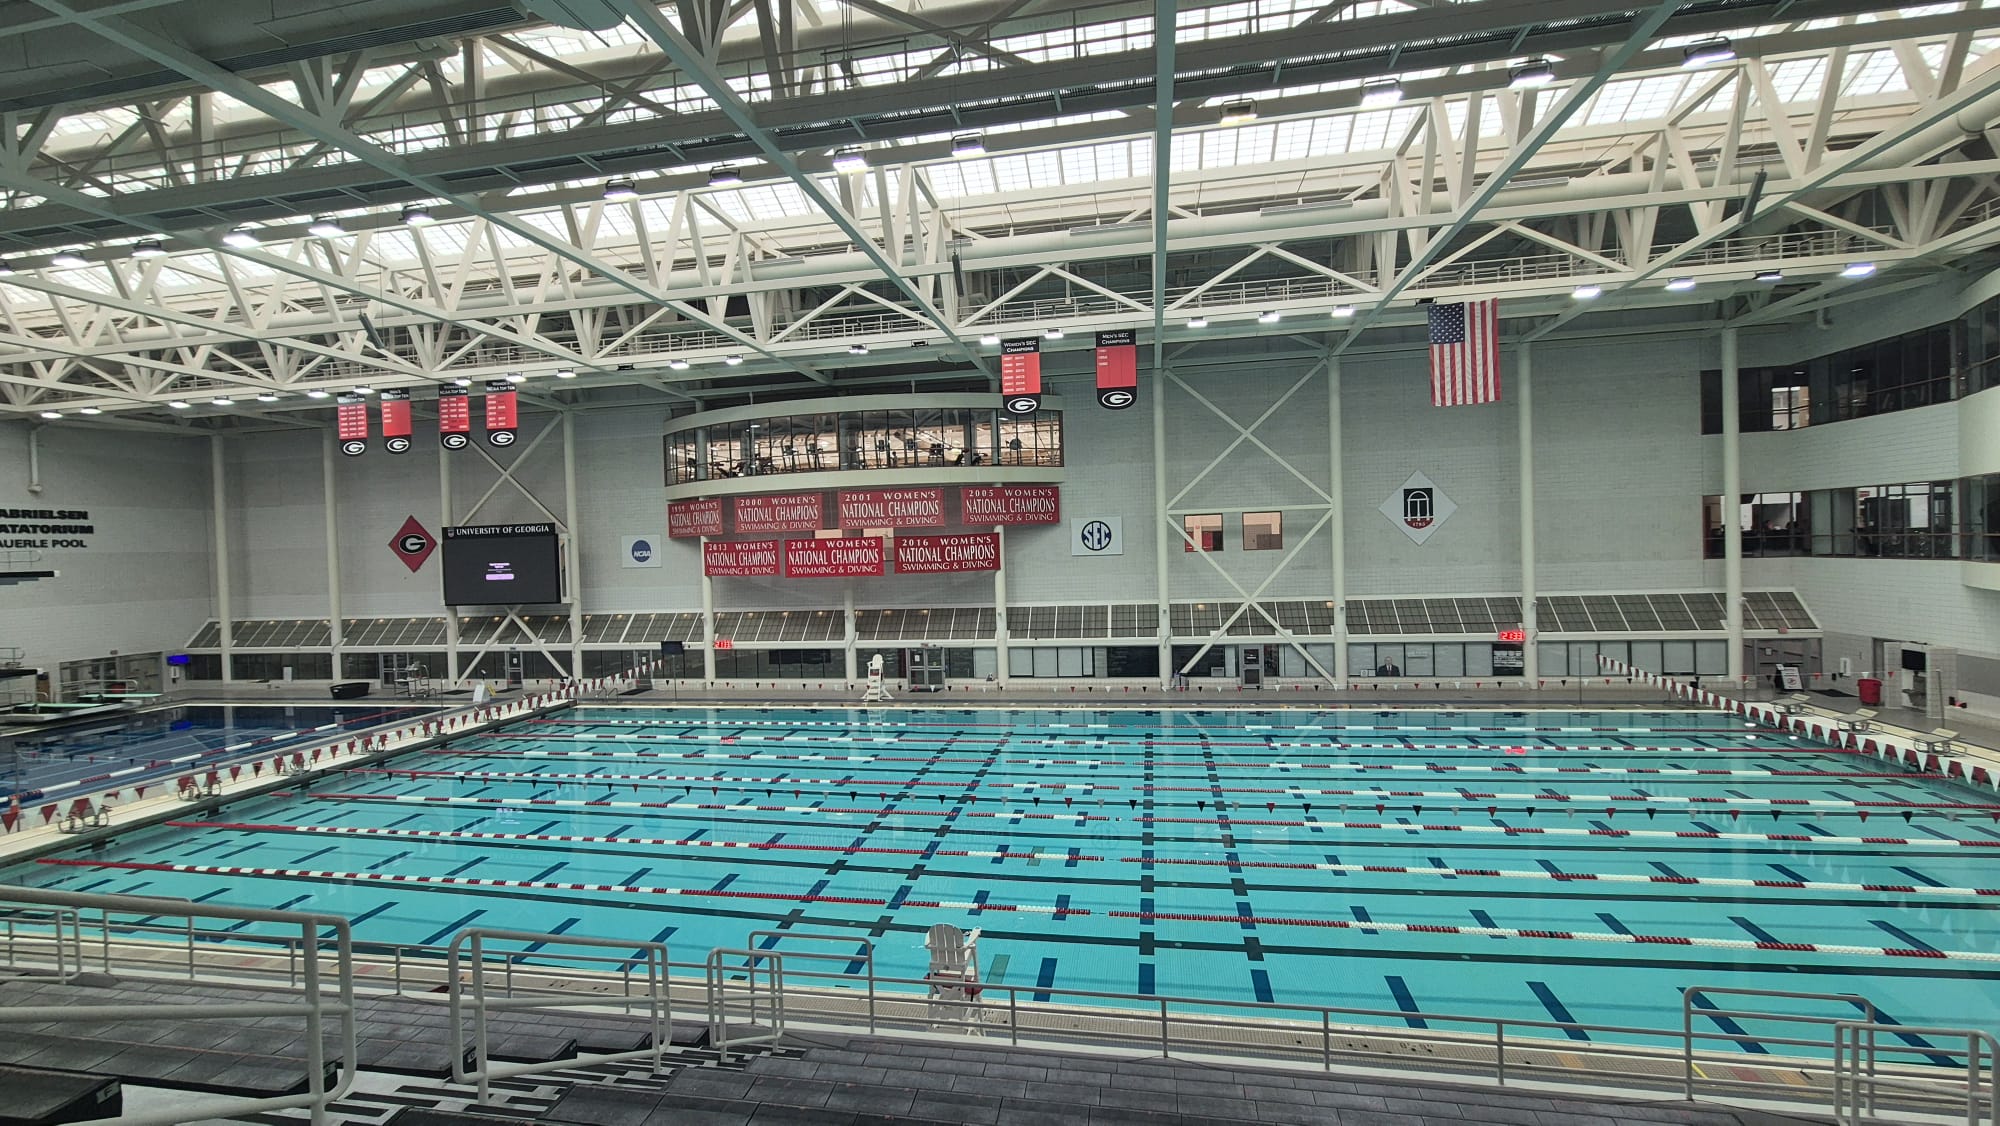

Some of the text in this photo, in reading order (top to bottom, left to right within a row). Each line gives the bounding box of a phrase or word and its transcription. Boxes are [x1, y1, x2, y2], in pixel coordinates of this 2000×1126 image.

[771, 496, 816, 505] WOMEN'S
[882, 491, 936, 500] WOMEN'S
[842, 500, 939, 518] NATIONAL CHAMPIONS
[966, 498, 1055, 514] NATIONAL CHAMPIONS
[738, 505, 818, 522] NATIONAL CHAMPIONS
[969, 514, 1013, 522] SWIMMING
[846, 518, 893, 527] SWIMMING
[906, 516, 937, 525] DIVING
[456, 527, 500, 535] UNIVERSITY
[740, 523, 779, 531] SWIMMING
[940, 536, 991, 545] WOMEN'S
[1082, 522, 1110, 550] SEC
[52, 540, 87, 548] POOL
[735, 541, 773, 550] WOMEN'S
[791, 539, 876, 549] 2014 WOMEN'S
[707, 550, 775, 566] NATIONAL CHAMPIONS
[788, 548, 879, 566] NATIONAL CHAMPIONS
[899, 544, 995, 562] NATIONAL CHAMPIONS
[792, 565, 835, 574] SWIMMING
[847, 565, 876, 573] DIVING
[903, 563, 950, 571] SWIMMING
[962, 560, 992, 569] DIVING
